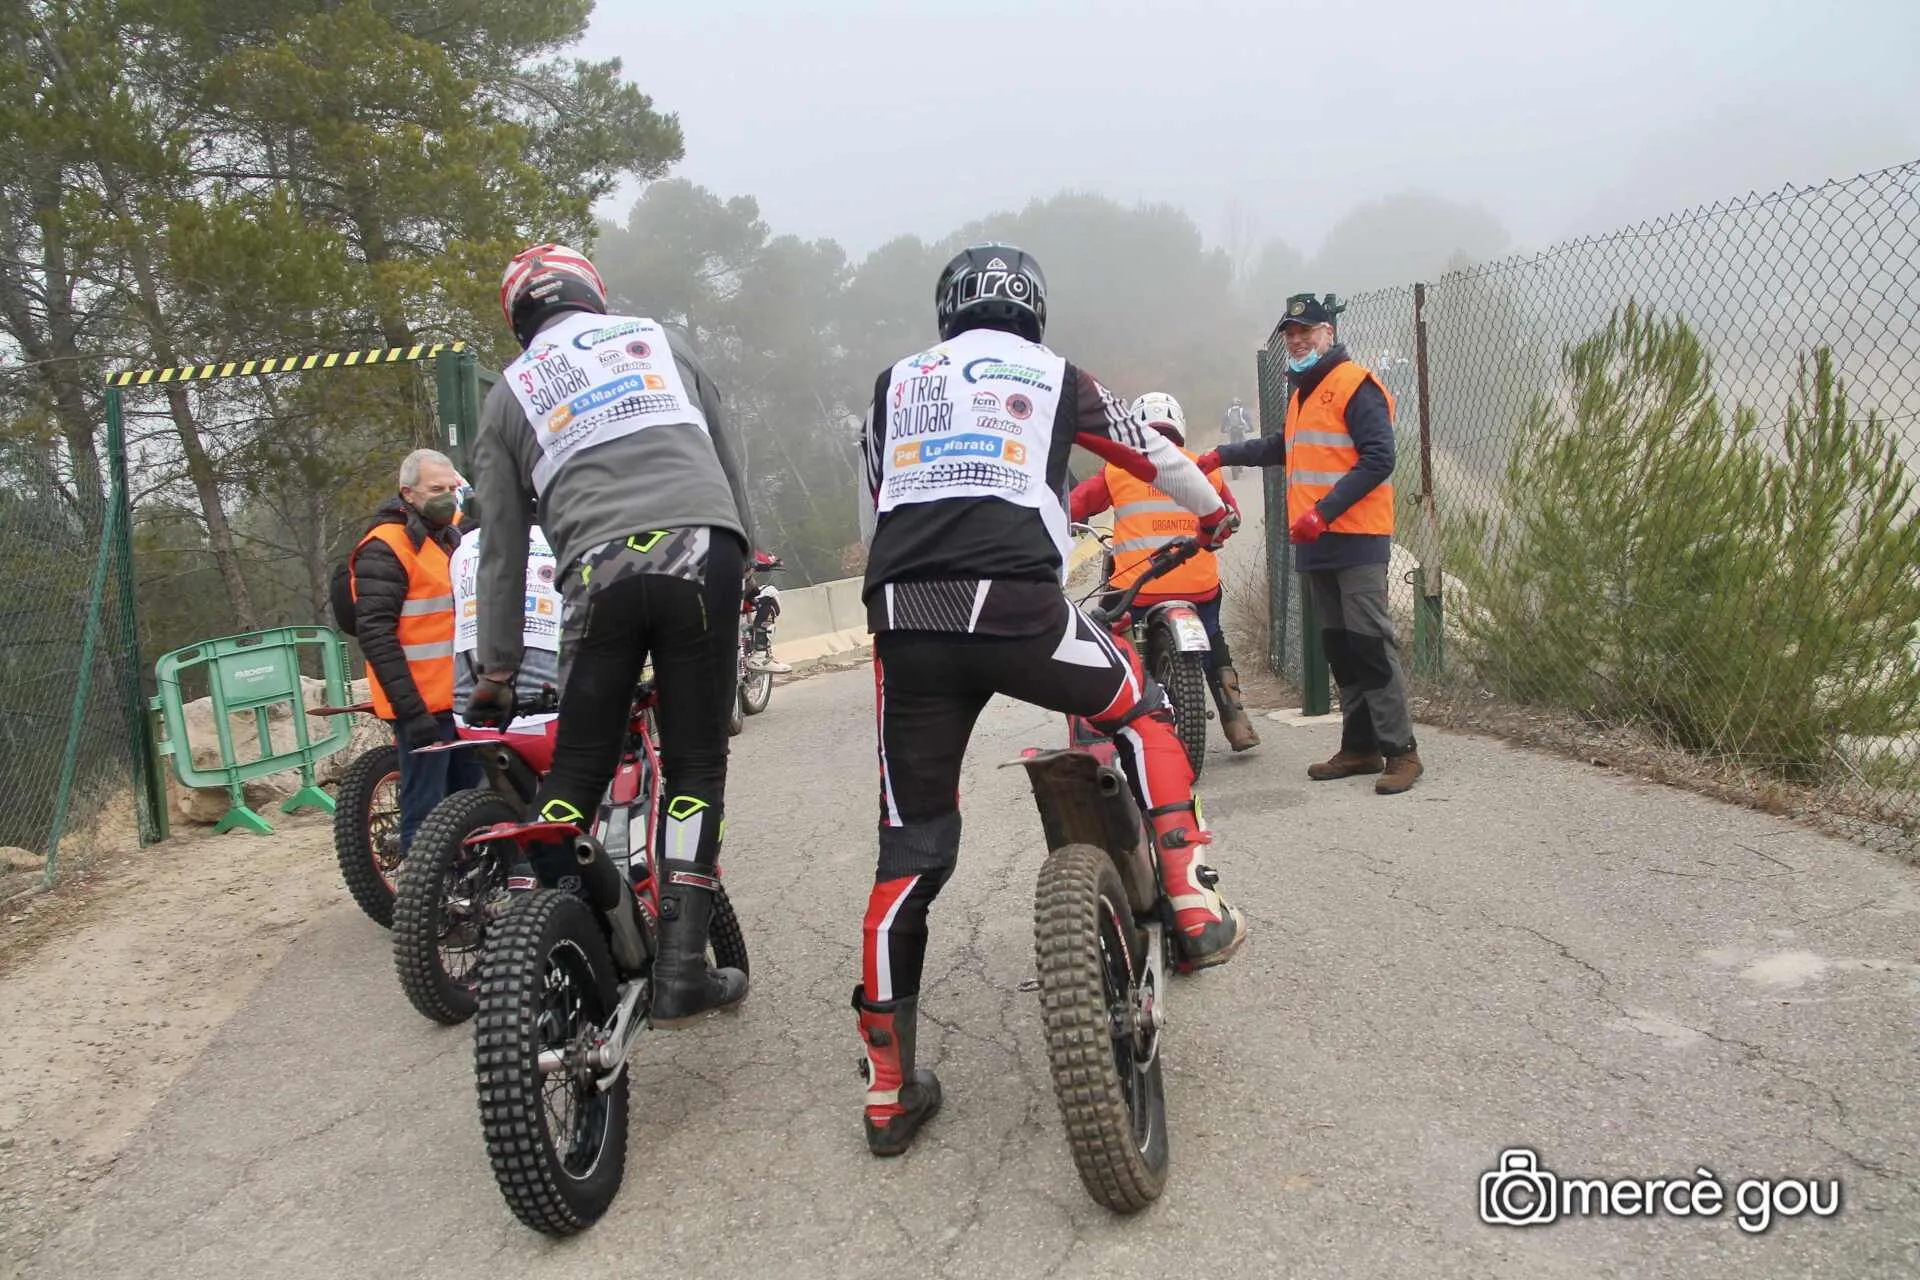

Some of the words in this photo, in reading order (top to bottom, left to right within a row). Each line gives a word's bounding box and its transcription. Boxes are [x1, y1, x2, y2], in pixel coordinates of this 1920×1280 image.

[592, 378, 640, 402] Marató
[979, 374, 1053, 393] PARCMOTOR
[973, 396, 996, 406] fcm
[925, 445, 942, 457] La
